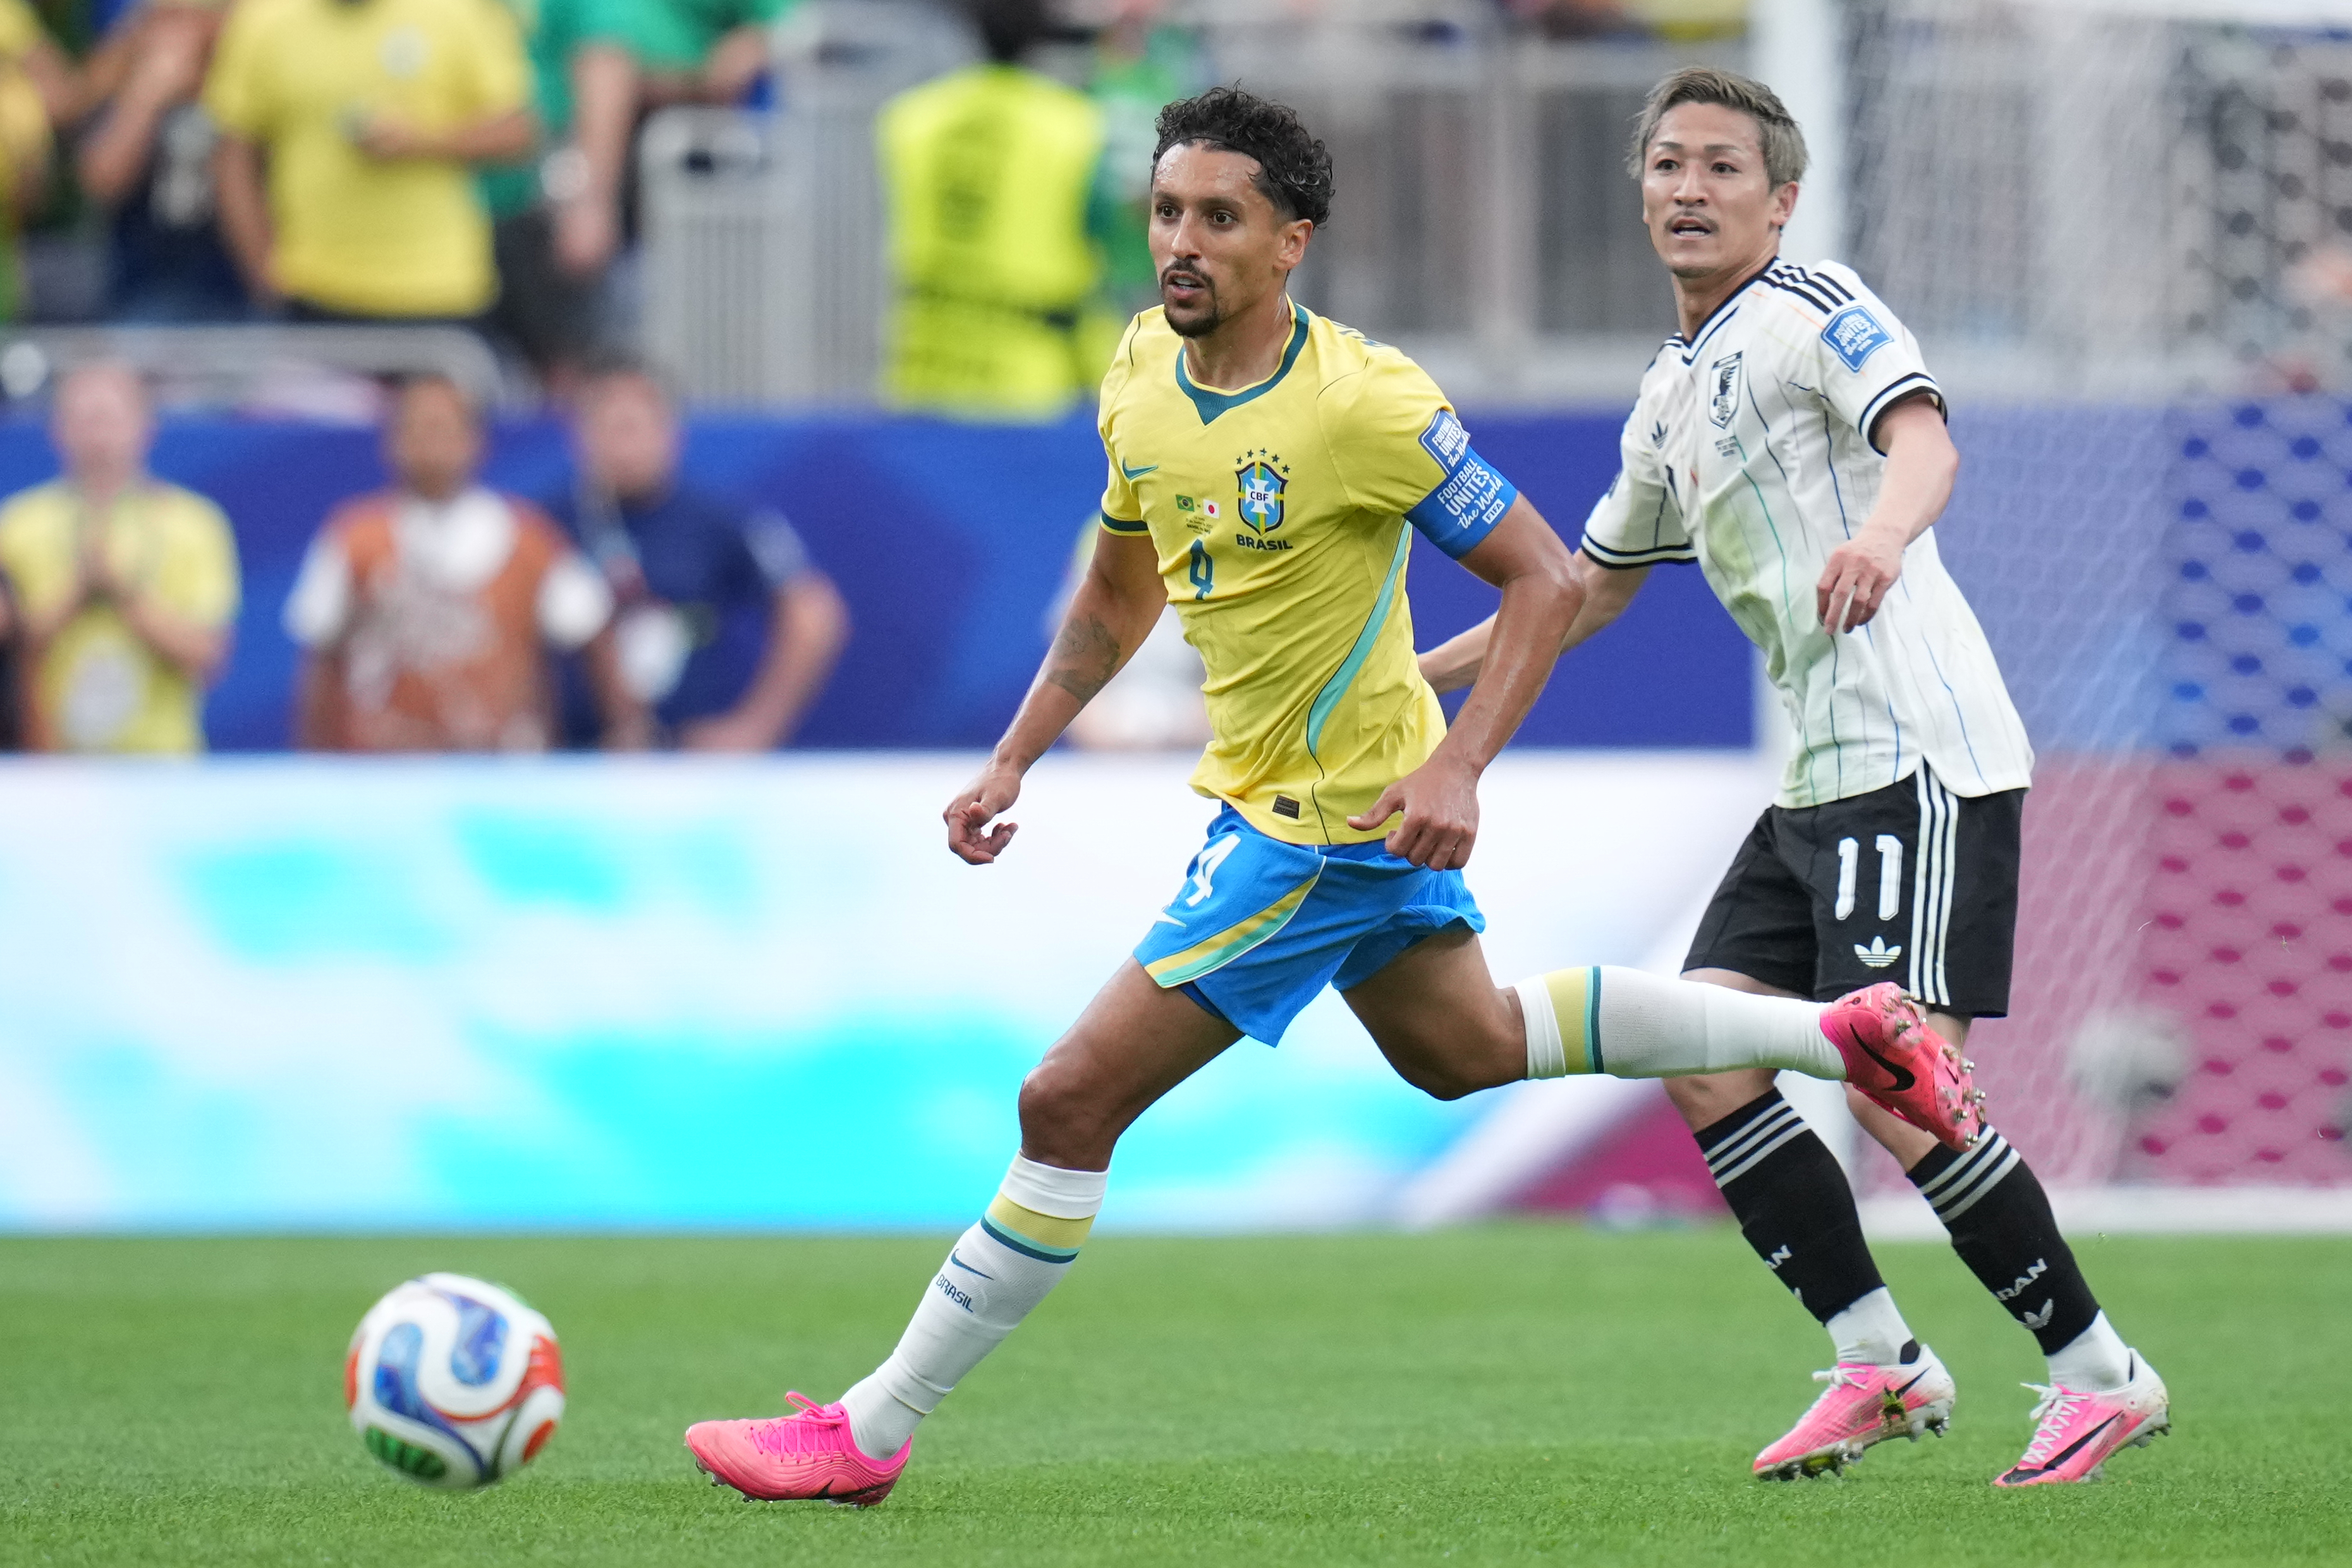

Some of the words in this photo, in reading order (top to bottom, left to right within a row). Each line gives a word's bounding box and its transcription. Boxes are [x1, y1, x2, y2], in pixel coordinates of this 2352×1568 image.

[1438, 423, 1461, 456] UNITES
[1437, 458, 1478, 504] FOOTBALL
[1447, 453, 1460, 468] the
[1250, 490, 1269, 502] CBF
[1445, 466, 1490, 516] UNITES
[1457, 507, 1480, 529] the
[1474, 474, 1504, 511] World
[1485, 501, 1504, 522] FIFA
[1236, 533, 1294, 551] BRASIL
[1185, 832, 1241, 907] 4
[1835, 834, 1903, 921] 11
[935, 1273, 973, 1313] BRASIL
[1996, 1258, 2048, 1301] PAN
